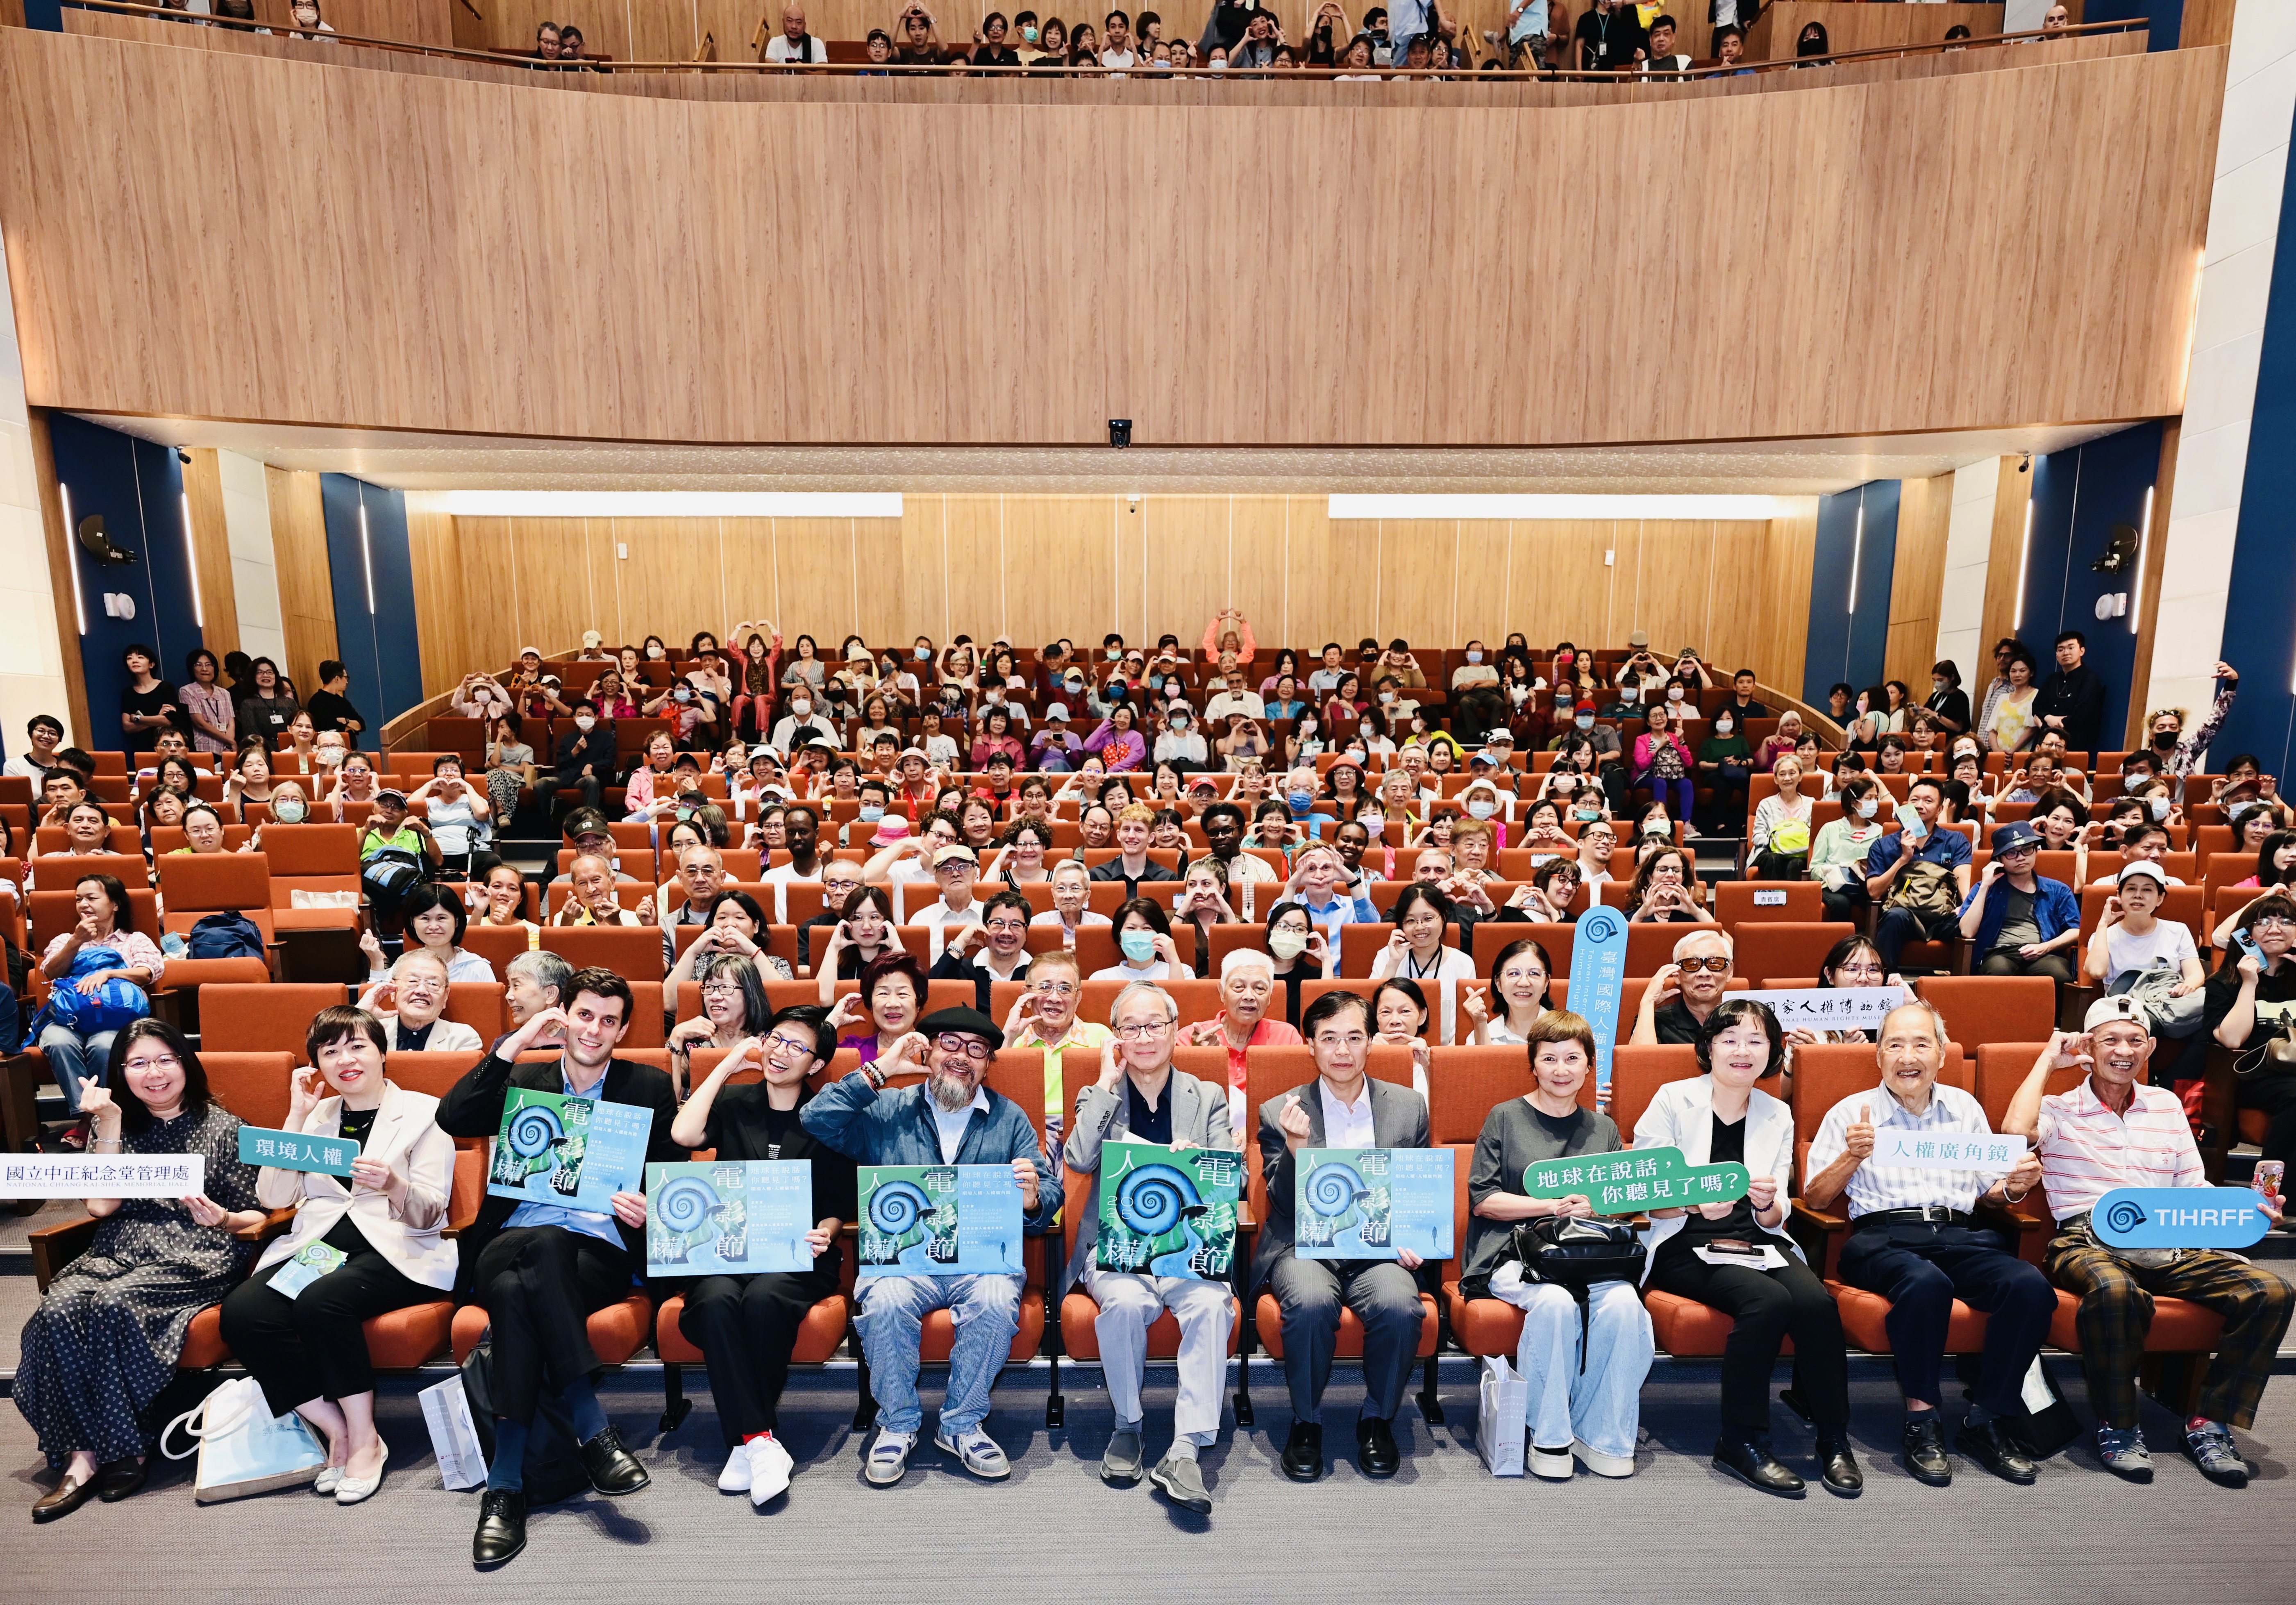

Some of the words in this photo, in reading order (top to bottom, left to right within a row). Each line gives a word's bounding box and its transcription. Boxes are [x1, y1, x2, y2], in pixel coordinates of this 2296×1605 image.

[1577, 949, 1585, 981] Human
[1585, 949, 1594, 982] Taiwan
[1581, 986, 1590, 1018] Interna
[255, 1139, 343, 1166] 環境人權
[548, 1102, 590, 1191] 電影節
[1890, 1141, 2008, 1162] 人權廣角鏡
[7, 1165, 190, 1181] 國立中正紀念堂管理處
[1537, 1158, 1672, 1188] 地球在說話，
[1601, 1173, 1739, 1205] 你聽見了嗎？
[712, 1167, 744, 1258] 電影節
[1359, 1154, 1388, 1243] 電影節
[924, 1171, 955, 1259] 電影節
[1187, 1157, 1236, 1275] 電影節
[2154, 1209, 2254, 1226] TIHRFF
